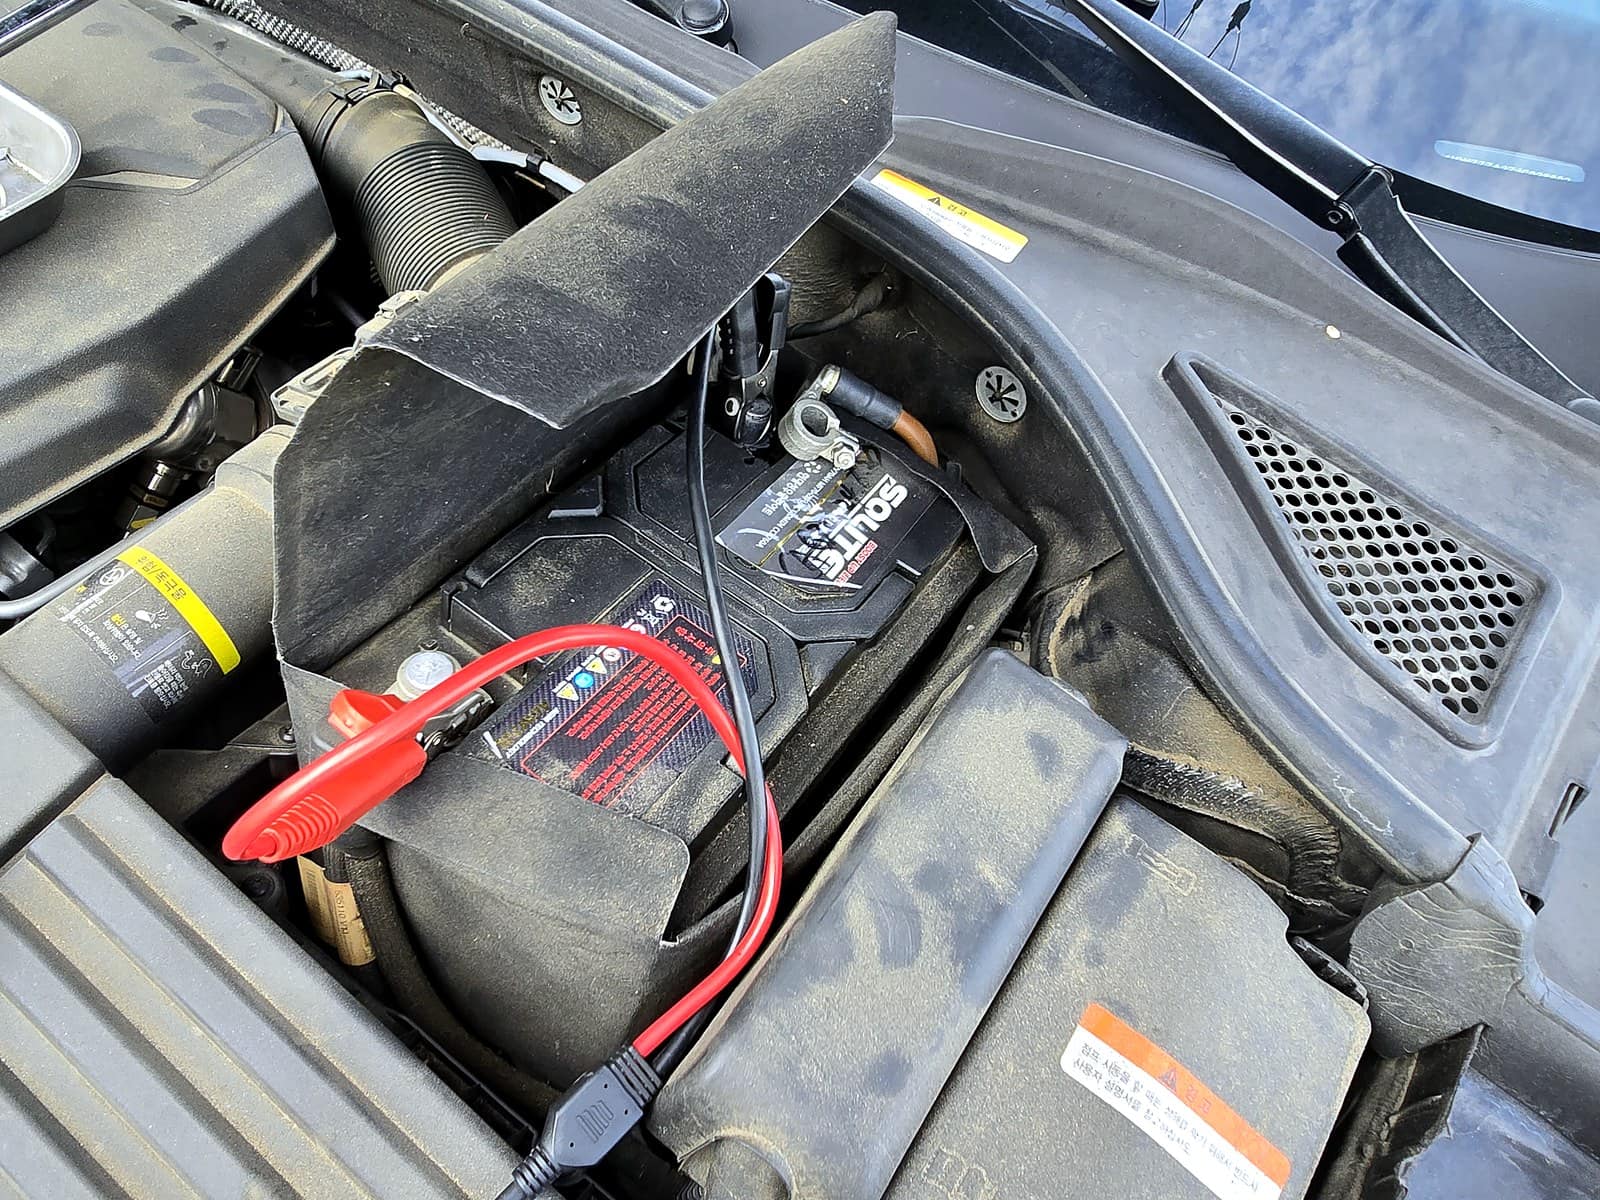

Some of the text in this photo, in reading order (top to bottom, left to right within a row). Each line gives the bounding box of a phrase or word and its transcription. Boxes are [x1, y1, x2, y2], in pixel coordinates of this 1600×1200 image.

[808, 473, 908, 580] SOLITE
[1073, 1058, 1102, 1085] 사용자
[1081, 1042, 1100, 1063] 점프
[1102, 1058, 1131, 1085] 시동을
